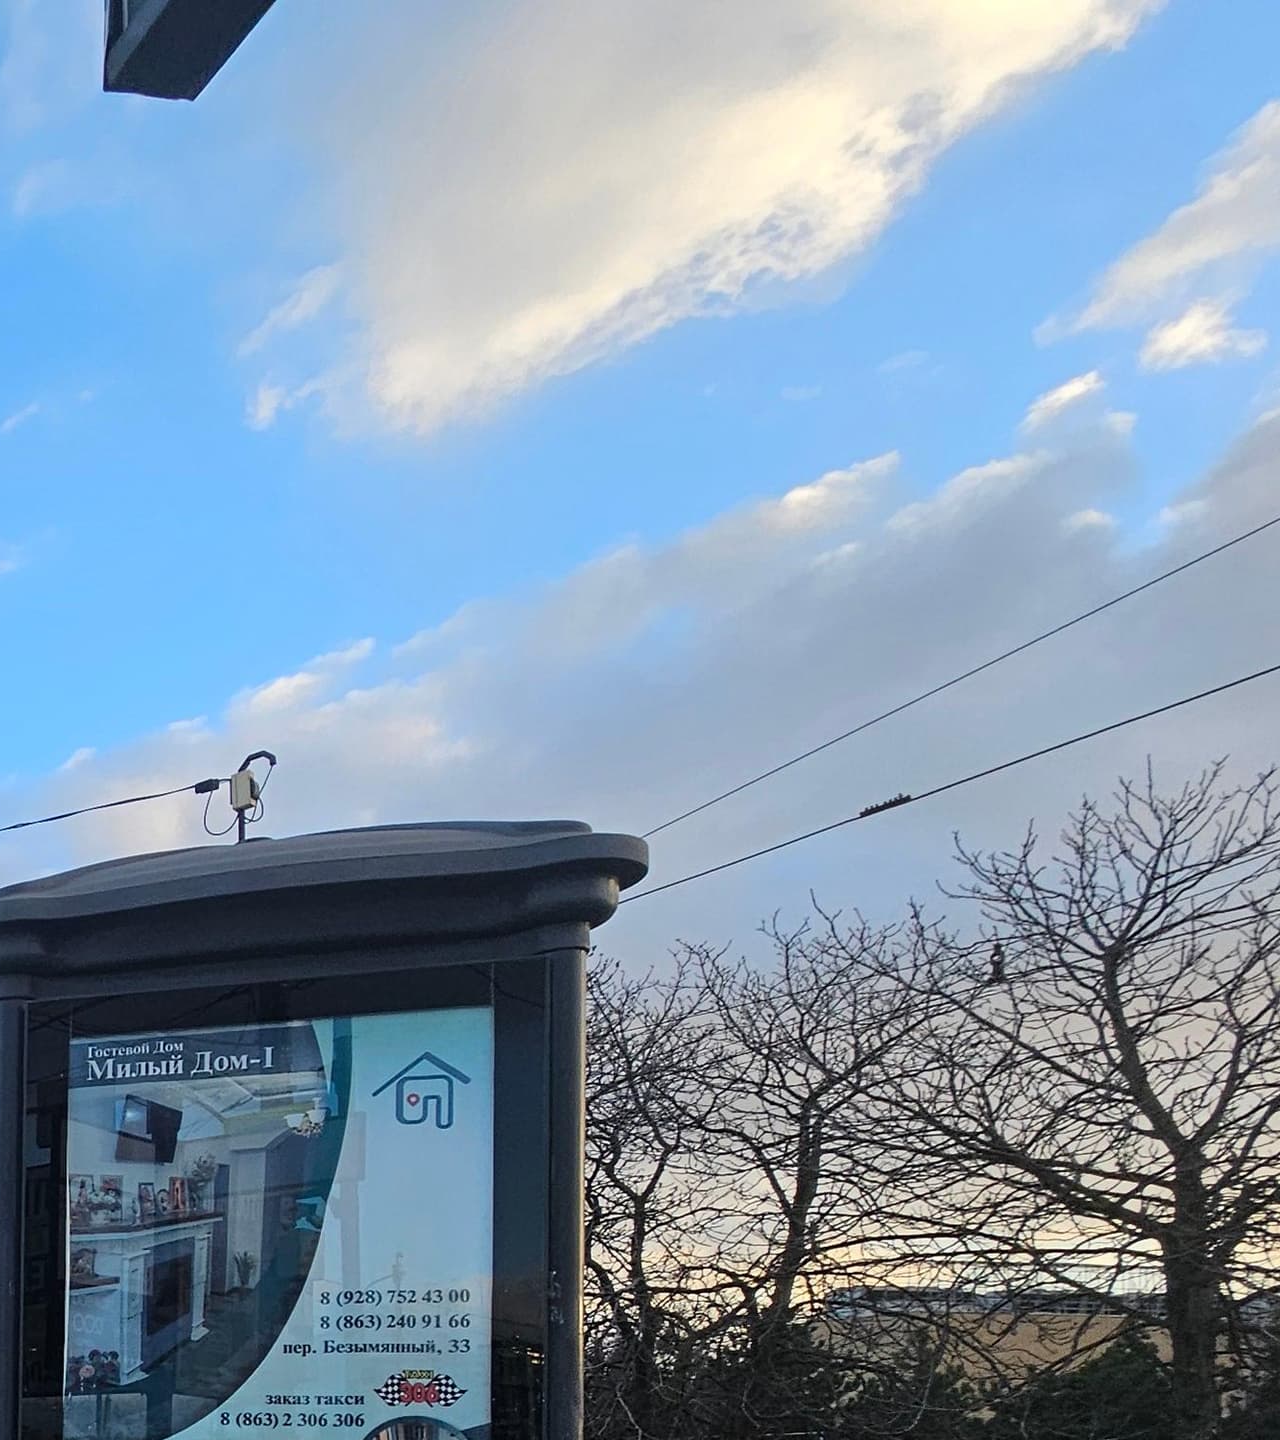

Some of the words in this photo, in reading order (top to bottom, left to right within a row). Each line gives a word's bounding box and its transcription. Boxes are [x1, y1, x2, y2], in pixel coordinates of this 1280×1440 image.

[88, 1043, 150, 1058] Гостевой
[153, 1041, 184, 1054] Дом
[86, 1055, 184, 1081] Милый
[191, 1046, 275, 1077] Дом-I
[320, 1291, 330, 1304] 8
[336, 1290, 382, 1307] (928)
[388, 1290, 416, 1303] 752
[422, 1289, 443, 1303] 43
[449, 1289, 470, 1303] 00
[320, 1316, 330, 1329] 8
[336, 1315, 382, 1331] (863)
[387, 1315, 416, 1328] 240
[422, 1315, 442, 1328] 91
[449, 1314, 470, 1328] 66
[283, 1342, 316, 1356] пер.
[324, 1340, 442, 1355] Безымянный,
[448, 1339, 470, 1353] 33
[265, 1394, 309, 1405] заказ
[315, 1394, 365, 1405] такси
[400, 1382, 440, 1403] 306
[220, 1412, 230, 1425] 8
[236, 1412, 279, 1429] (863)
[283, 1414, 292, 1427] 2
[297, 1414, 328, 1427] 306
[333, 1414, 365, 1427] 306
